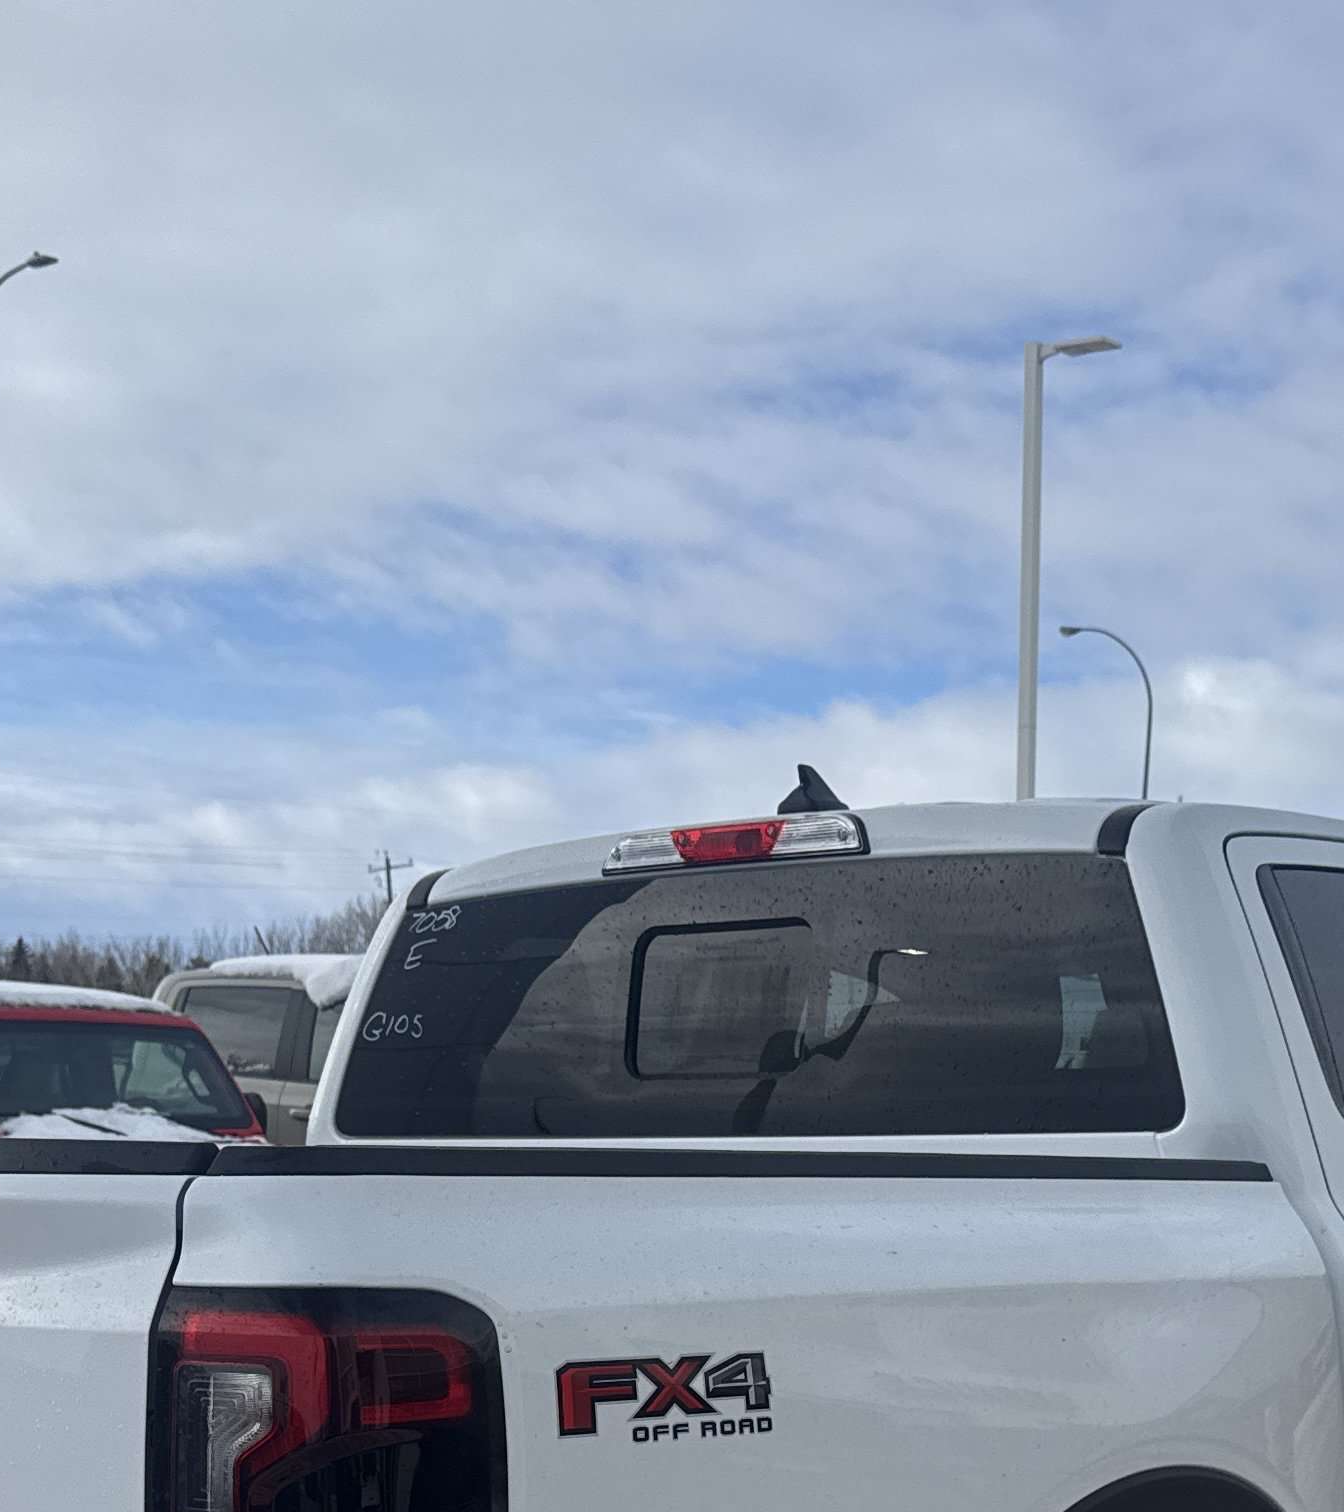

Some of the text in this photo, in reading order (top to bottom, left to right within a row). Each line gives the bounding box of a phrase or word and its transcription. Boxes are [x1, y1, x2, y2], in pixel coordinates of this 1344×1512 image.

[404, 938, 437, 970] E
[362, 1011, 423, 1041] G105
[556, 1351, 772, 1438] FX4
[632, 1416, 773, 1443] OFF ROAD
